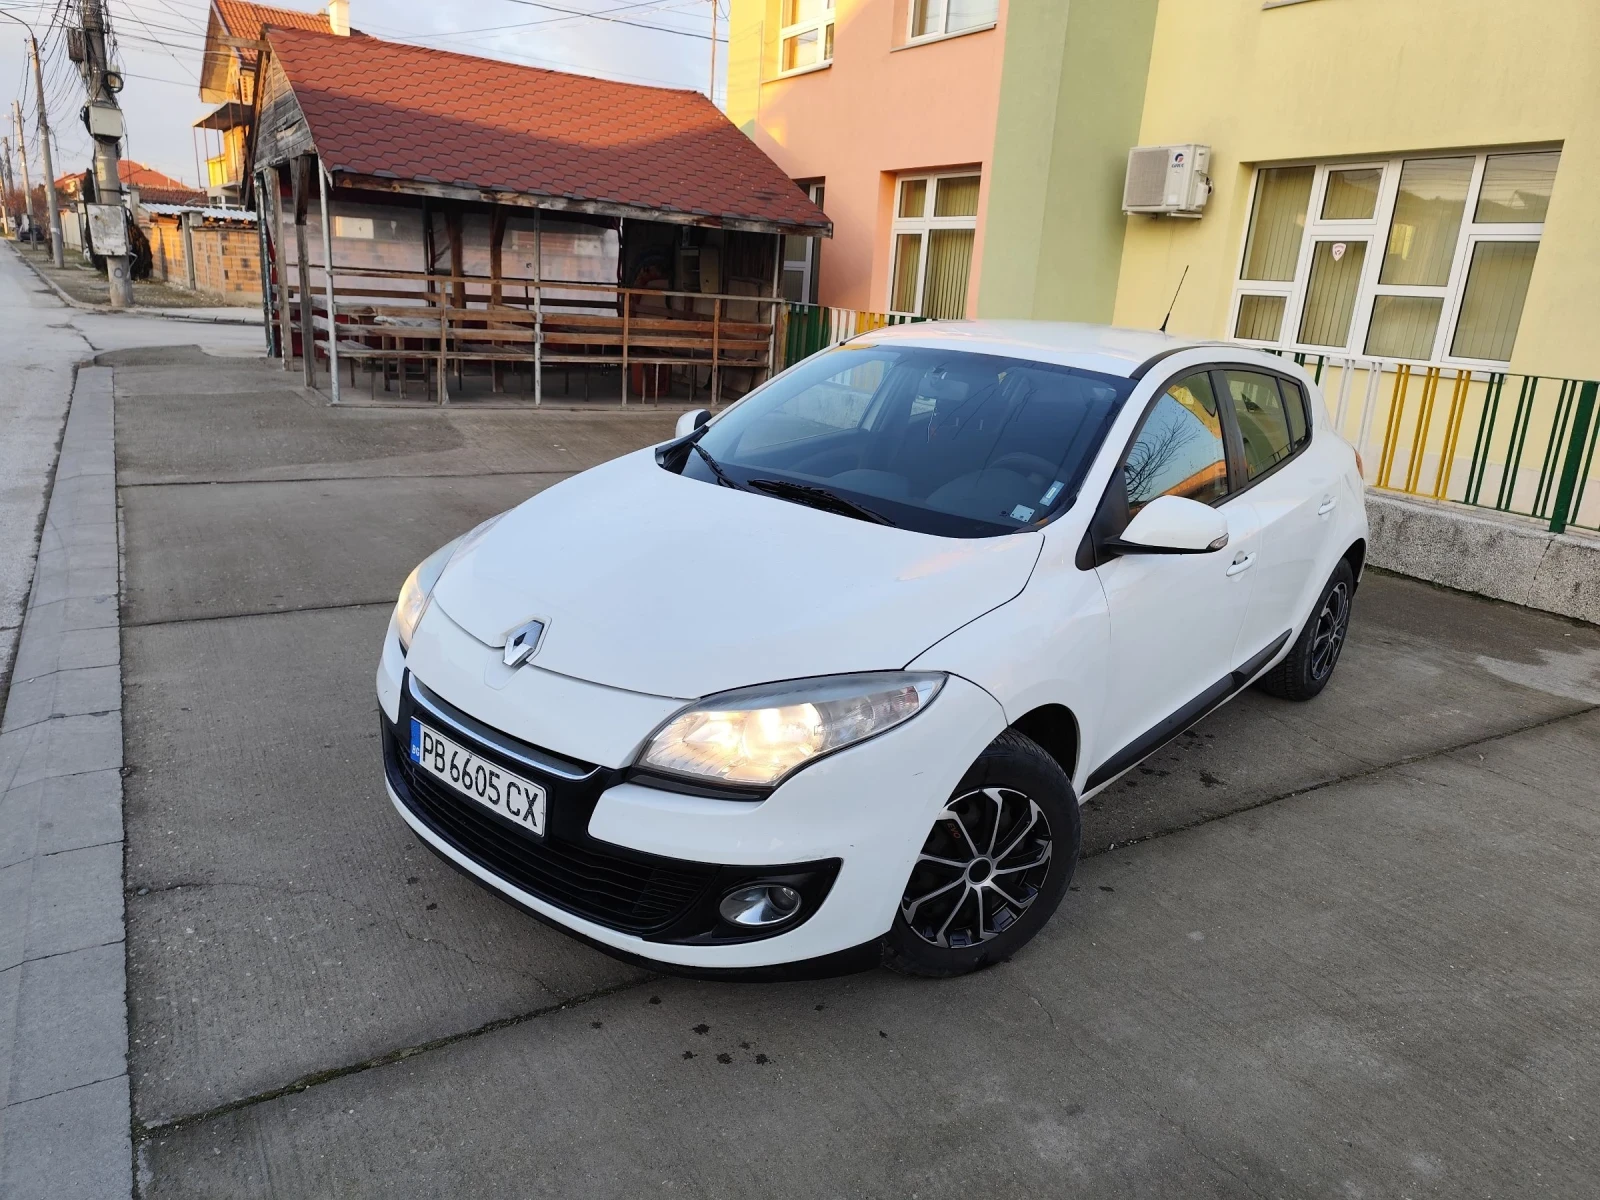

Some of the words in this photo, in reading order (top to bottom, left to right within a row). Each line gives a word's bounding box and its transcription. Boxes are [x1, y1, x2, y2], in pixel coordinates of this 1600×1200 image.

[412, 744, 420, 756] BG
[423, 731, 445, 773] PB
[450, 751, 500, 805] 6605
[506, 781, 538, 827] CX
[947, 823, 961, 839] EVO
